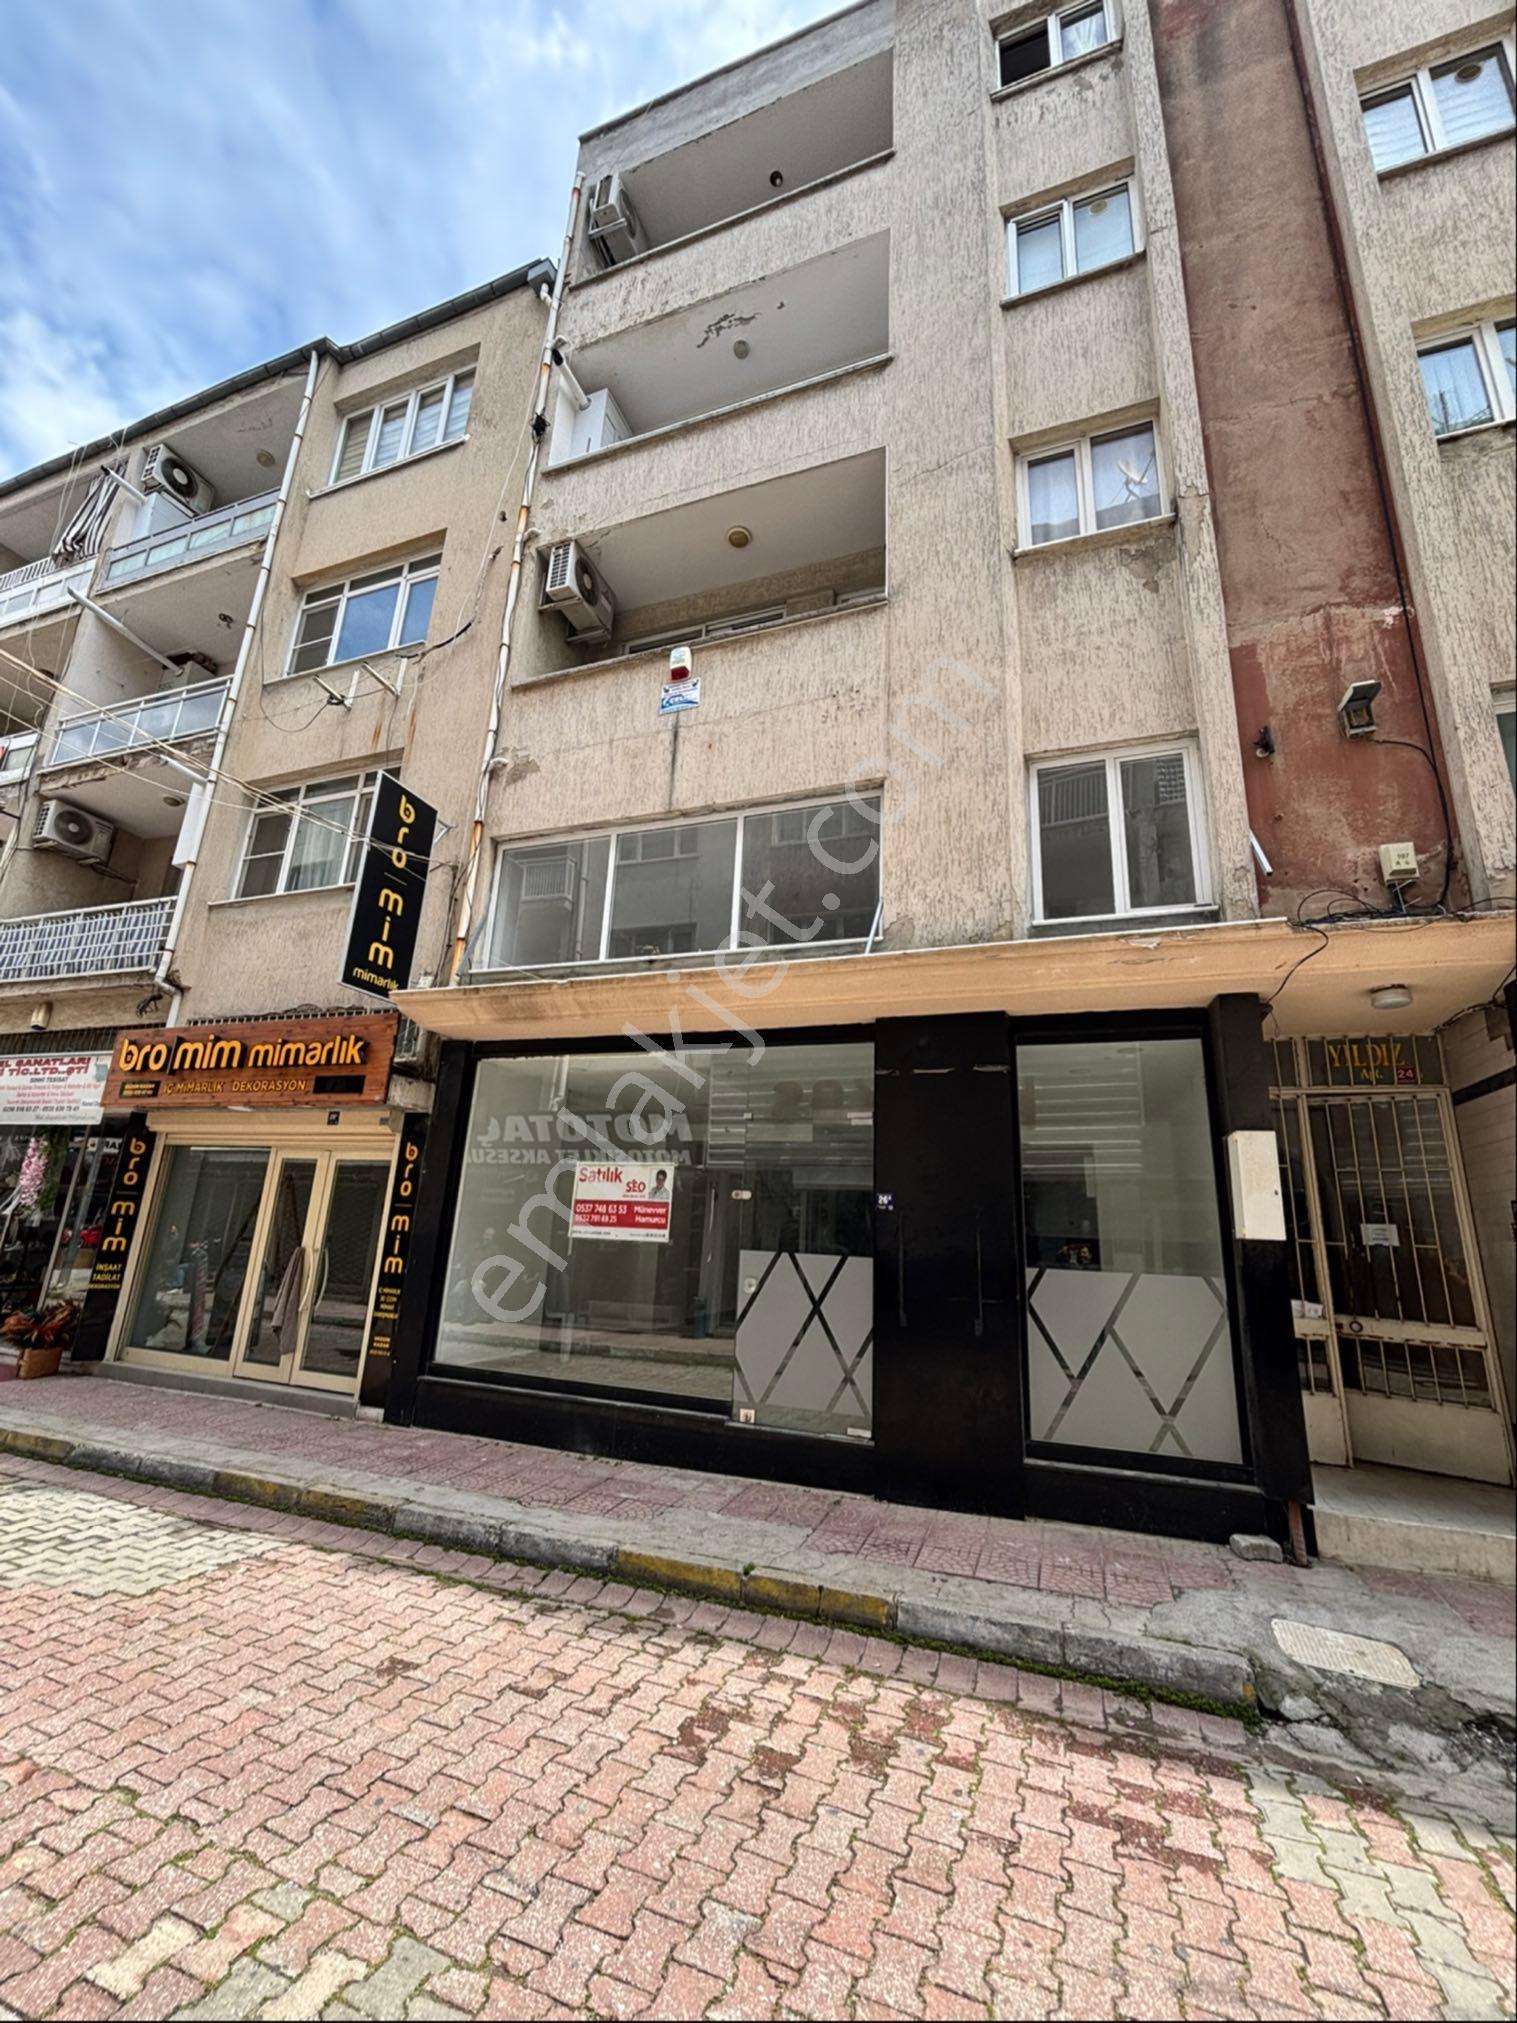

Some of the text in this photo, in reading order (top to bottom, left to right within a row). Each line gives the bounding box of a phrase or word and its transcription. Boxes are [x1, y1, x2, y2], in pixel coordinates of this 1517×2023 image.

[367, 794, 416, 970] bro mim
[119, 1033, 365, 1072] bro mim mimarlık
[1398, 1069, 1414, 1079] 24
[231, 1079, 307, 1092] DEKORASYON
[400, 1142, 418, 1197] bro
[579, 1167, 623, 1183] Satılık
[102, 1138, 146, 1251] bro mim
[384, 1214, 409, 1274] mim
